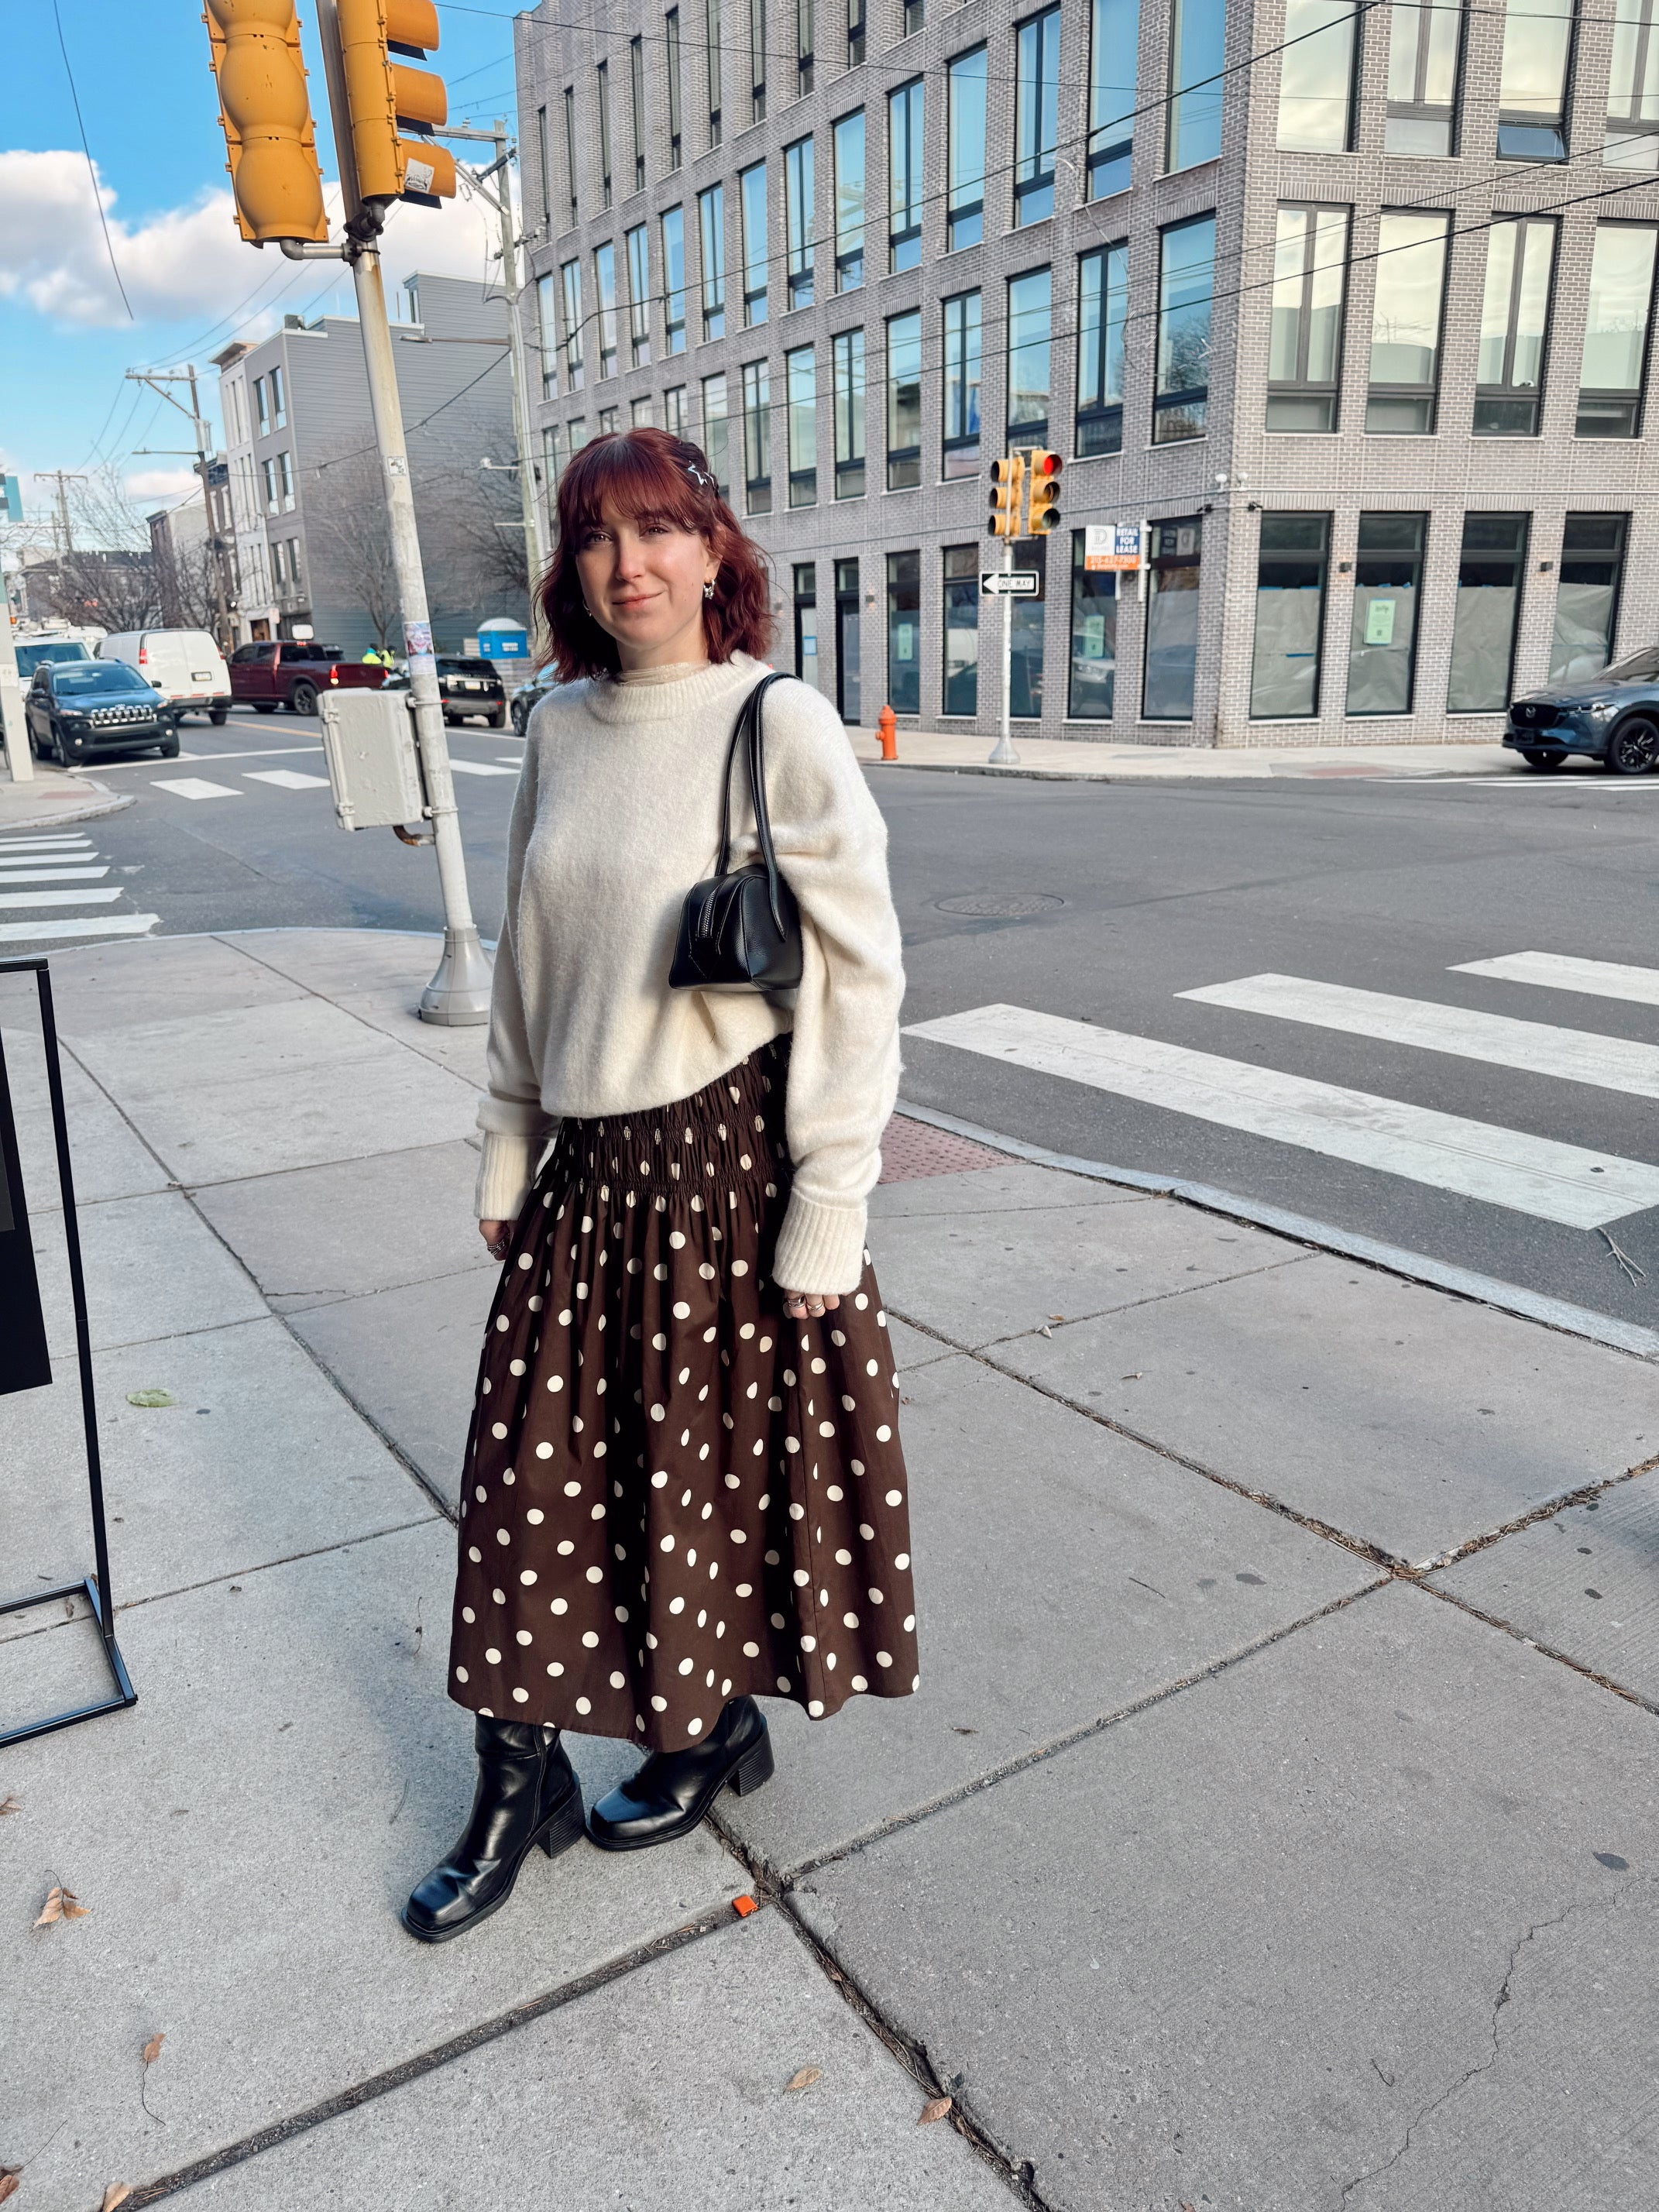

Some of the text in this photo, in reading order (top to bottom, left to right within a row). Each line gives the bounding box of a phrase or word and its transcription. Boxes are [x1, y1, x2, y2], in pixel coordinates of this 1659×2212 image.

[1116, 527, 1139, 536] RETAIL
[1116, 545, 1138, 554] LEASE
[998, 579, 1031, 588] ONE WAY
